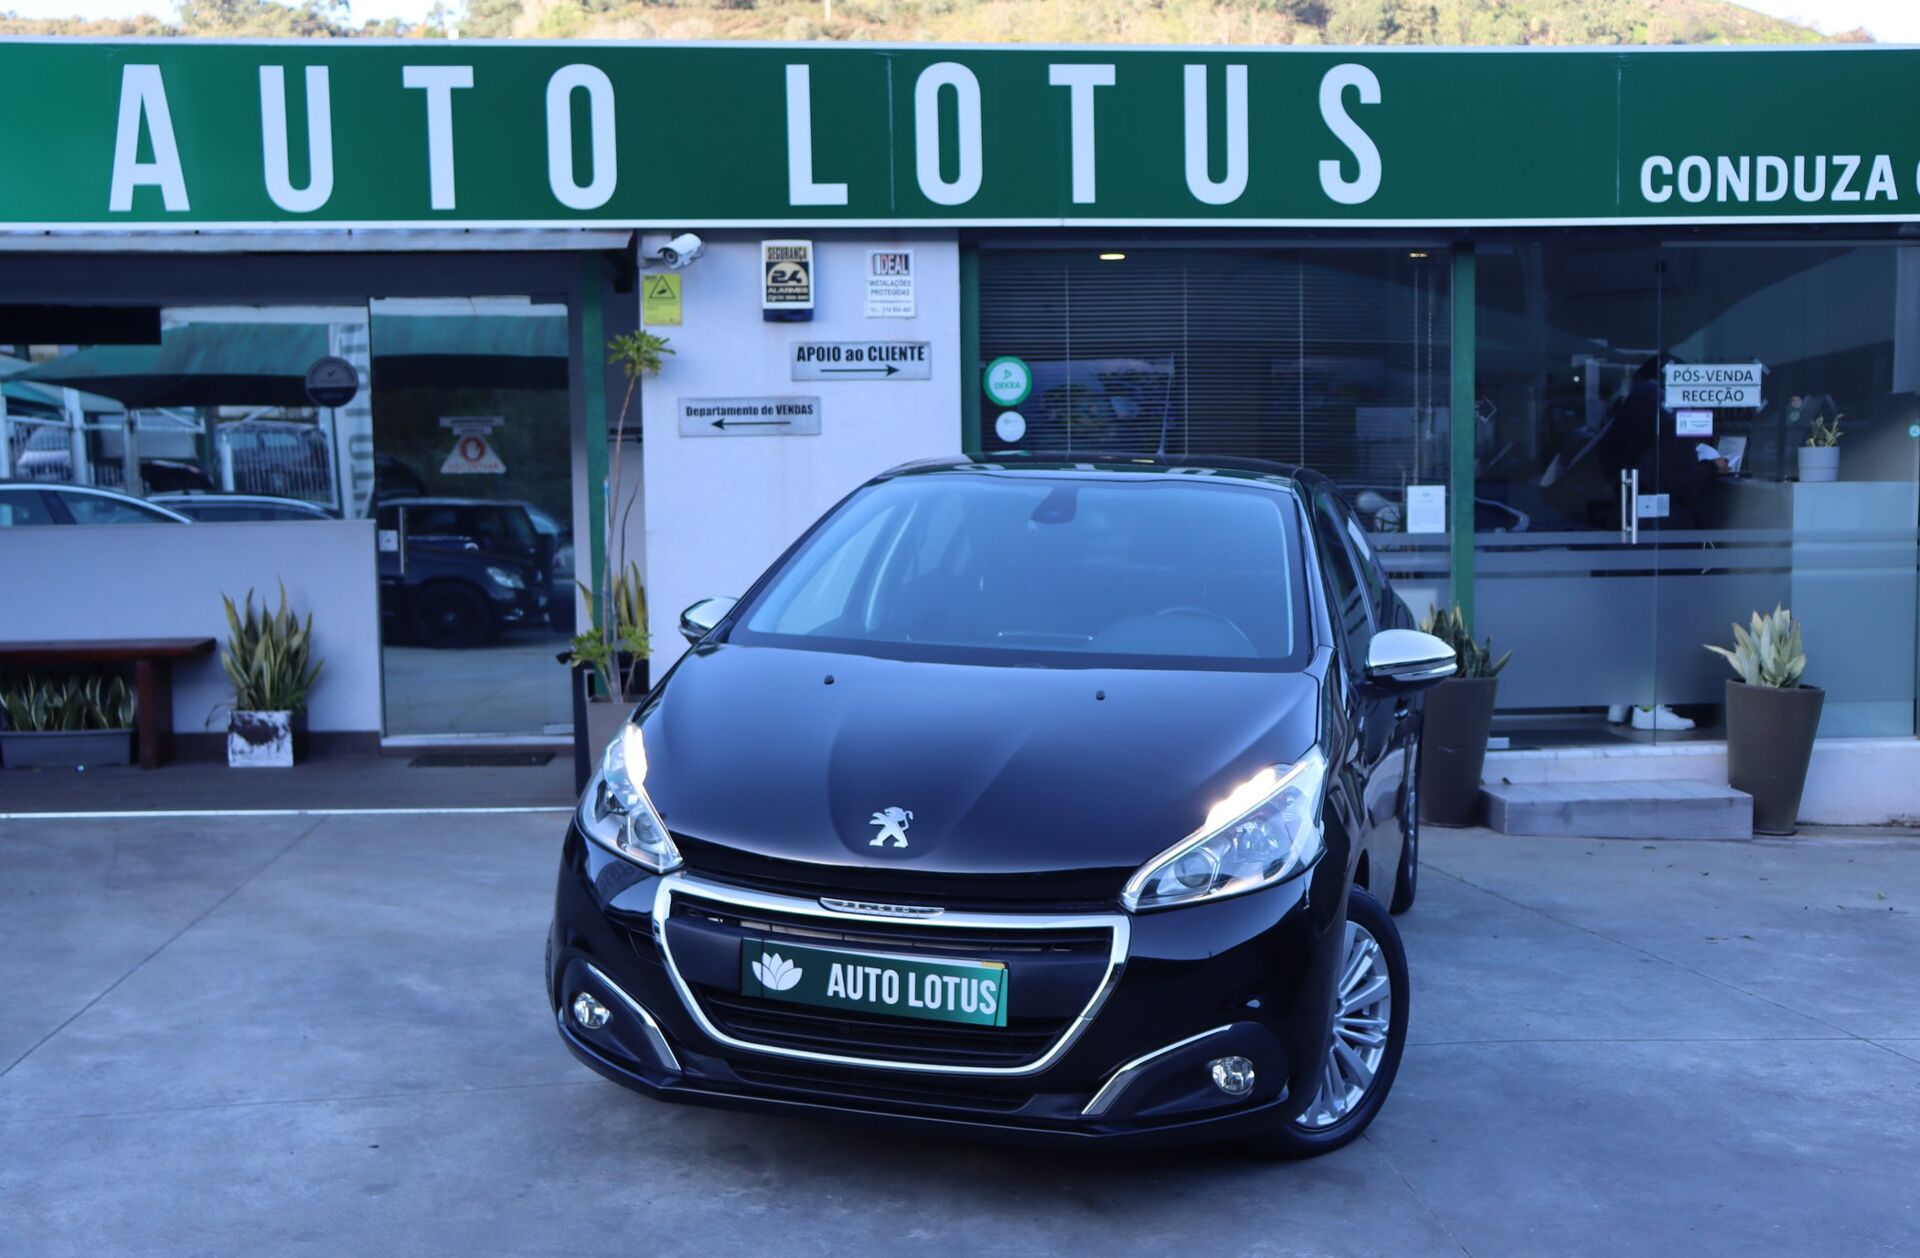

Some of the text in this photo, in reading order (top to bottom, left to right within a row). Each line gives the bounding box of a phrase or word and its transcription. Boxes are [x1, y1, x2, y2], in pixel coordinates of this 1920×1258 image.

[109, 62, 1382, 213] AUTO LOTUS
[1640, 154, 1899, 203] CONDUZA
[872, 254, 909, 274] IDEAL
[771, 269, 802, 284] 24
[796, 346, 925, 362] APOIO ao CLIENTE
[1673, 367, 1754, 382] PÓS-VENDA
[994, 381, 1021, 390] DEKRA
[1682, 387, 1744, 405] RECEÇÃO
[686, 404, 814, 418] Departamento de VENDAS
[827, 963, 997, 1015] AUTO LOTUS
